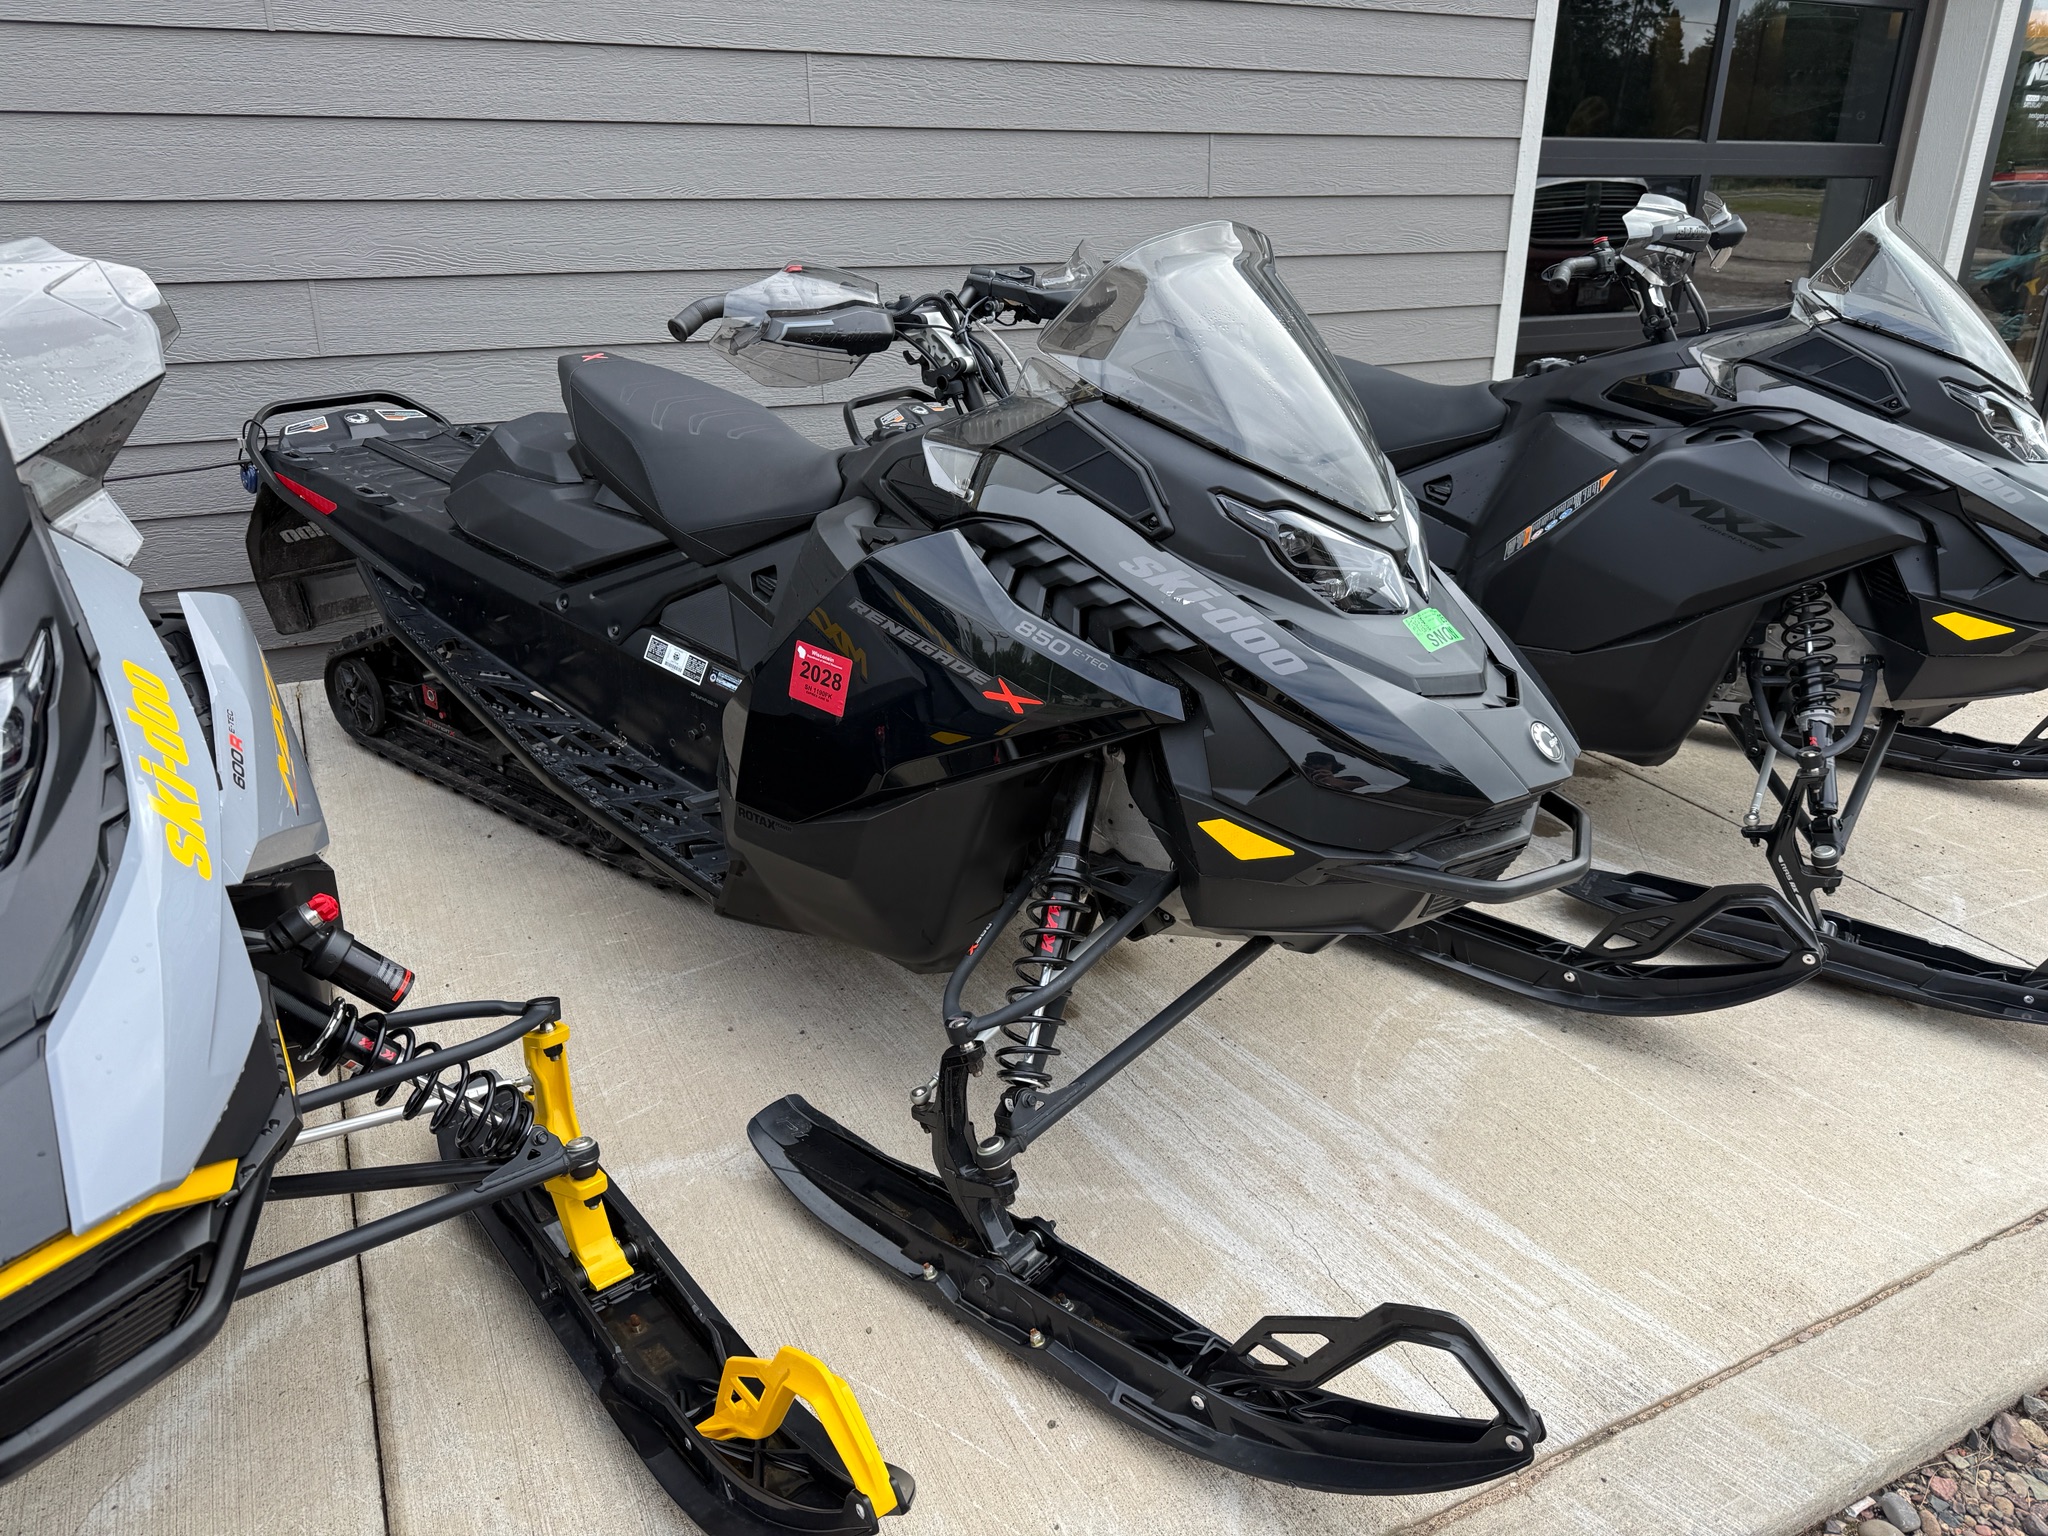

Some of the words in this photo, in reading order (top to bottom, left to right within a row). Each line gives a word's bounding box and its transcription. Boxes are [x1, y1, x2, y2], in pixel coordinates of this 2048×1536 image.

[1650, 482, 1805, 549] MXZ
[1811, 483, 1845, 500] 850
[1699, 523, 1764, 552] ADRENALINE
[1118, 556, 1308, 676] ski-doo
[849, 600, 993, 685] RENEGADE
[982, 677, 1043, 714] X
[1015, 620, 1071, 656] 850
[1072, 648, 1108, 671] E-TEC
[800, 661, 842, 691] 2028
[227, 709, 235, 734] E-TEC
[122, 660, 212, 881] ski-doo
[229, 733, 246, 790] 600R
[738, 806, 776, 831] ROTAX
